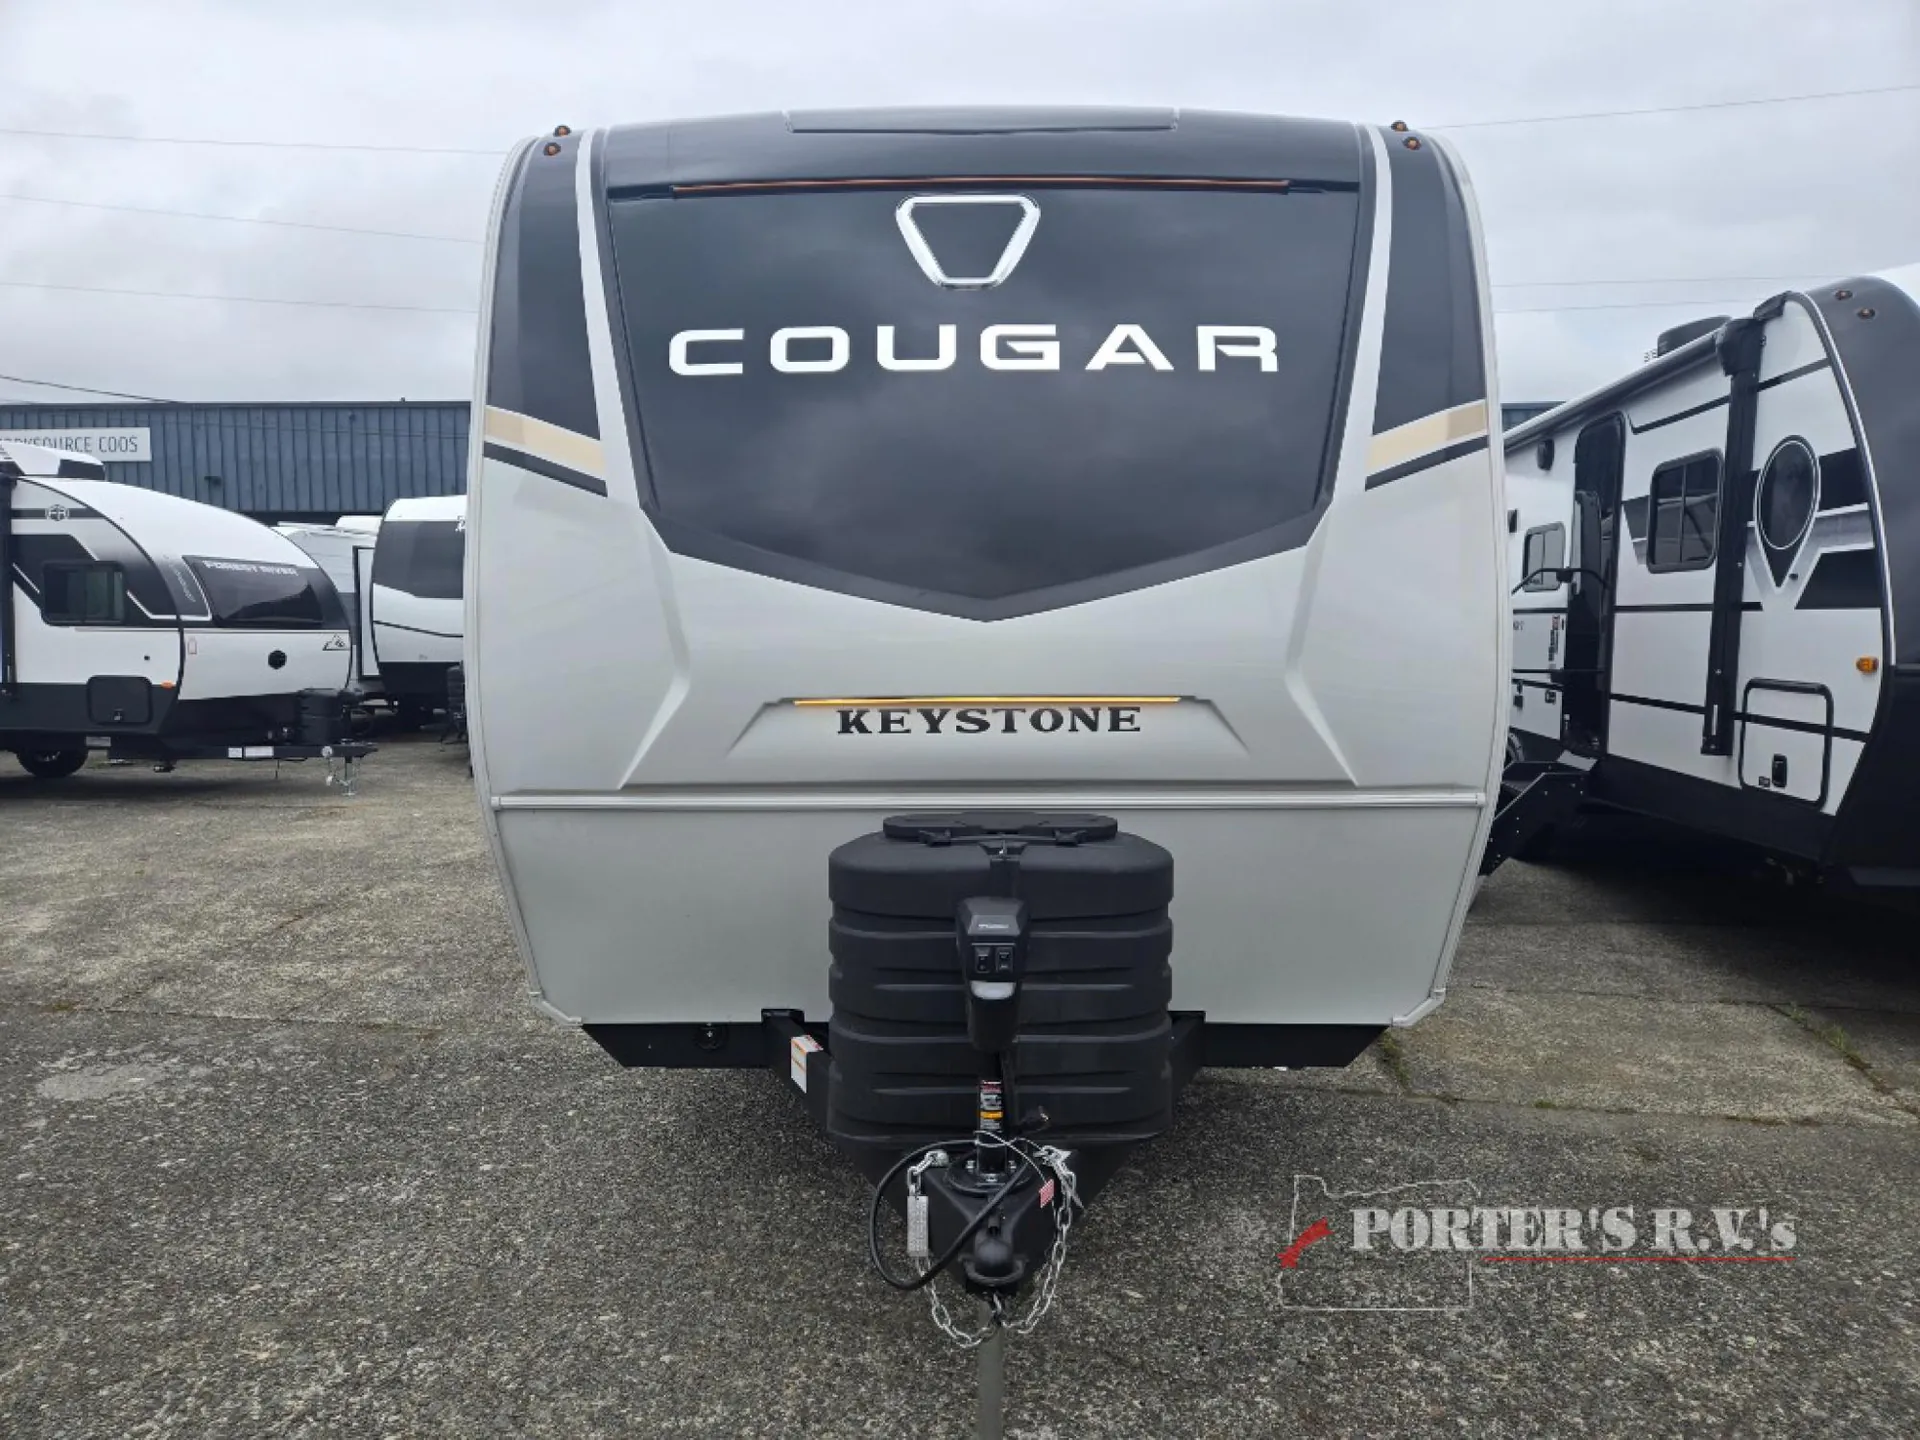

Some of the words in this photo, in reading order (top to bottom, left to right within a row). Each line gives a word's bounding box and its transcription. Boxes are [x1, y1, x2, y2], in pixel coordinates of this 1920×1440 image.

[668, 323, 1279, 376] COUGAR
[99, 436, 138, 453] COOS
[837, 706, 1141, 734] KEYSTONE
